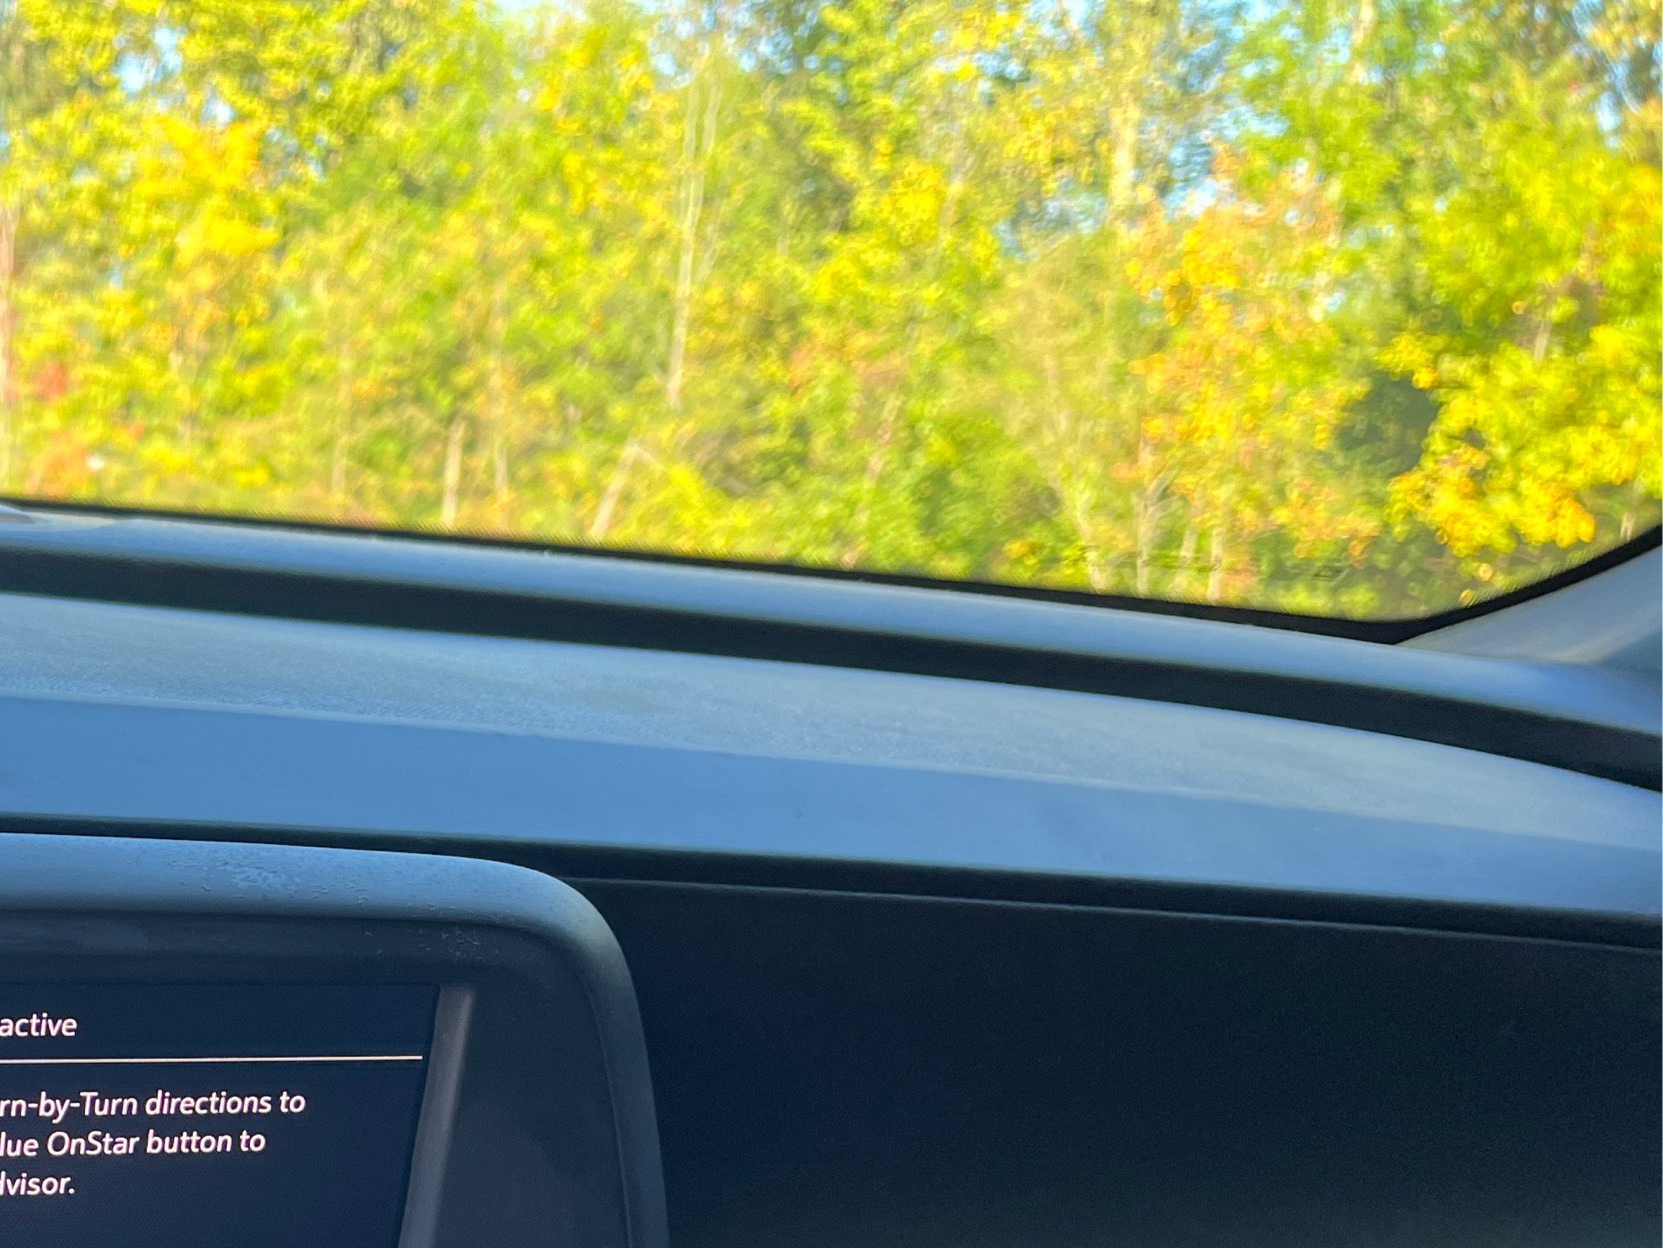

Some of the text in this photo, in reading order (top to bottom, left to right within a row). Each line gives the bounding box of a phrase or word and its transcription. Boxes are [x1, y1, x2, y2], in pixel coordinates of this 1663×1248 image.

[144, 1089, 272, 1116] directions
[279, 1090, 306, 1114] to
[46, 1130, 141, 1157] OnStar
[146, 1128, 233, 1155] button
[239, 1129, 266, 1153] to
